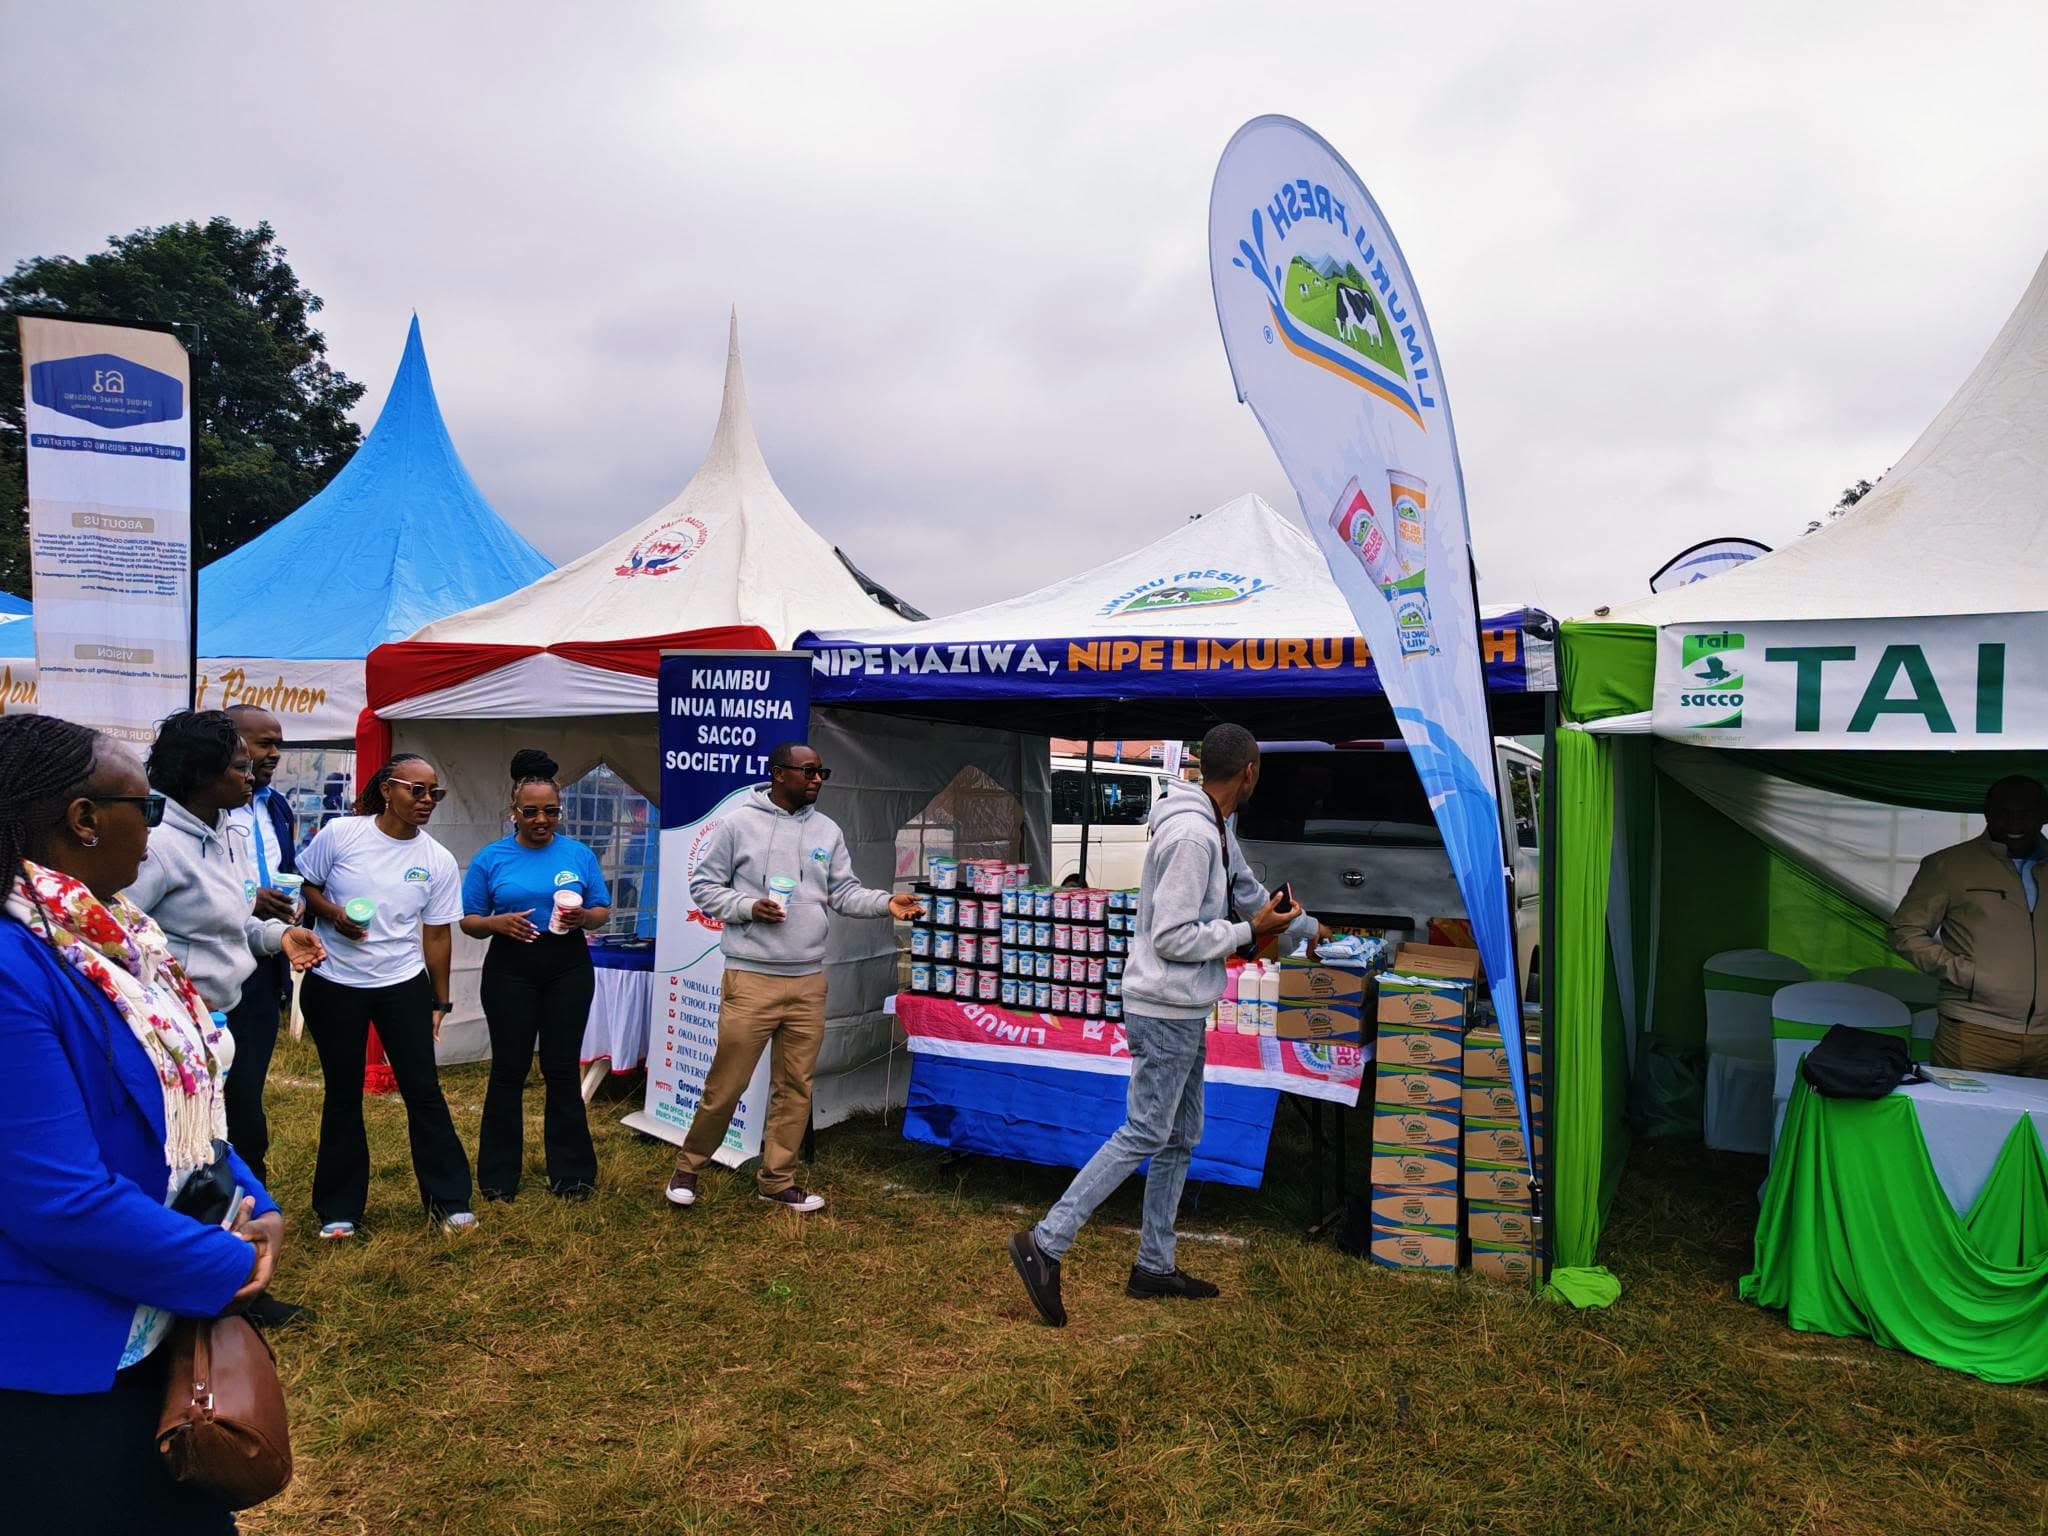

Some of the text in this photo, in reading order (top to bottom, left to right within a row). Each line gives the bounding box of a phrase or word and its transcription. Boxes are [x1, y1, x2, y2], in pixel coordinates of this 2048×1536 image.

[1096, 569, 1248, 616] LIMURU FRESH
[1695, 631, 1728, 648] Tai
[812, 643, 1059, 677] NIPE MAZIWA,
[1068, 639, 1176, 672] NIPE
[1183, 637, 1343, 671] LIMURU
[221, 667, 327, 713] Partner
[691, 669, 770, 691] KIAMBU
[1765, 643, 2006, 734] TAI
[671, 697, 794, 720] INUA MAISHA
[1681, 694, 1744, 707] sacco
[697, 725, 756, 746] SACCO
[665, 751, 771, 775] SOCIETY LT
[690, 838, 701, 860] INUA
[683, 978, 710, 994] NORMAL
[681, 995, 707, 1011] SCHOOL
[680, 1011, 717, 1030] EMERGENC
[956, 1002, 1046, 1045] LIMUR
[678, 1028, 696, 1041] OKOA
[676, 1060, 707, 1079] UNIVERSI
[678, 1080, 702, 1097] Growin
[676, 1094, 692, 1109] Build
